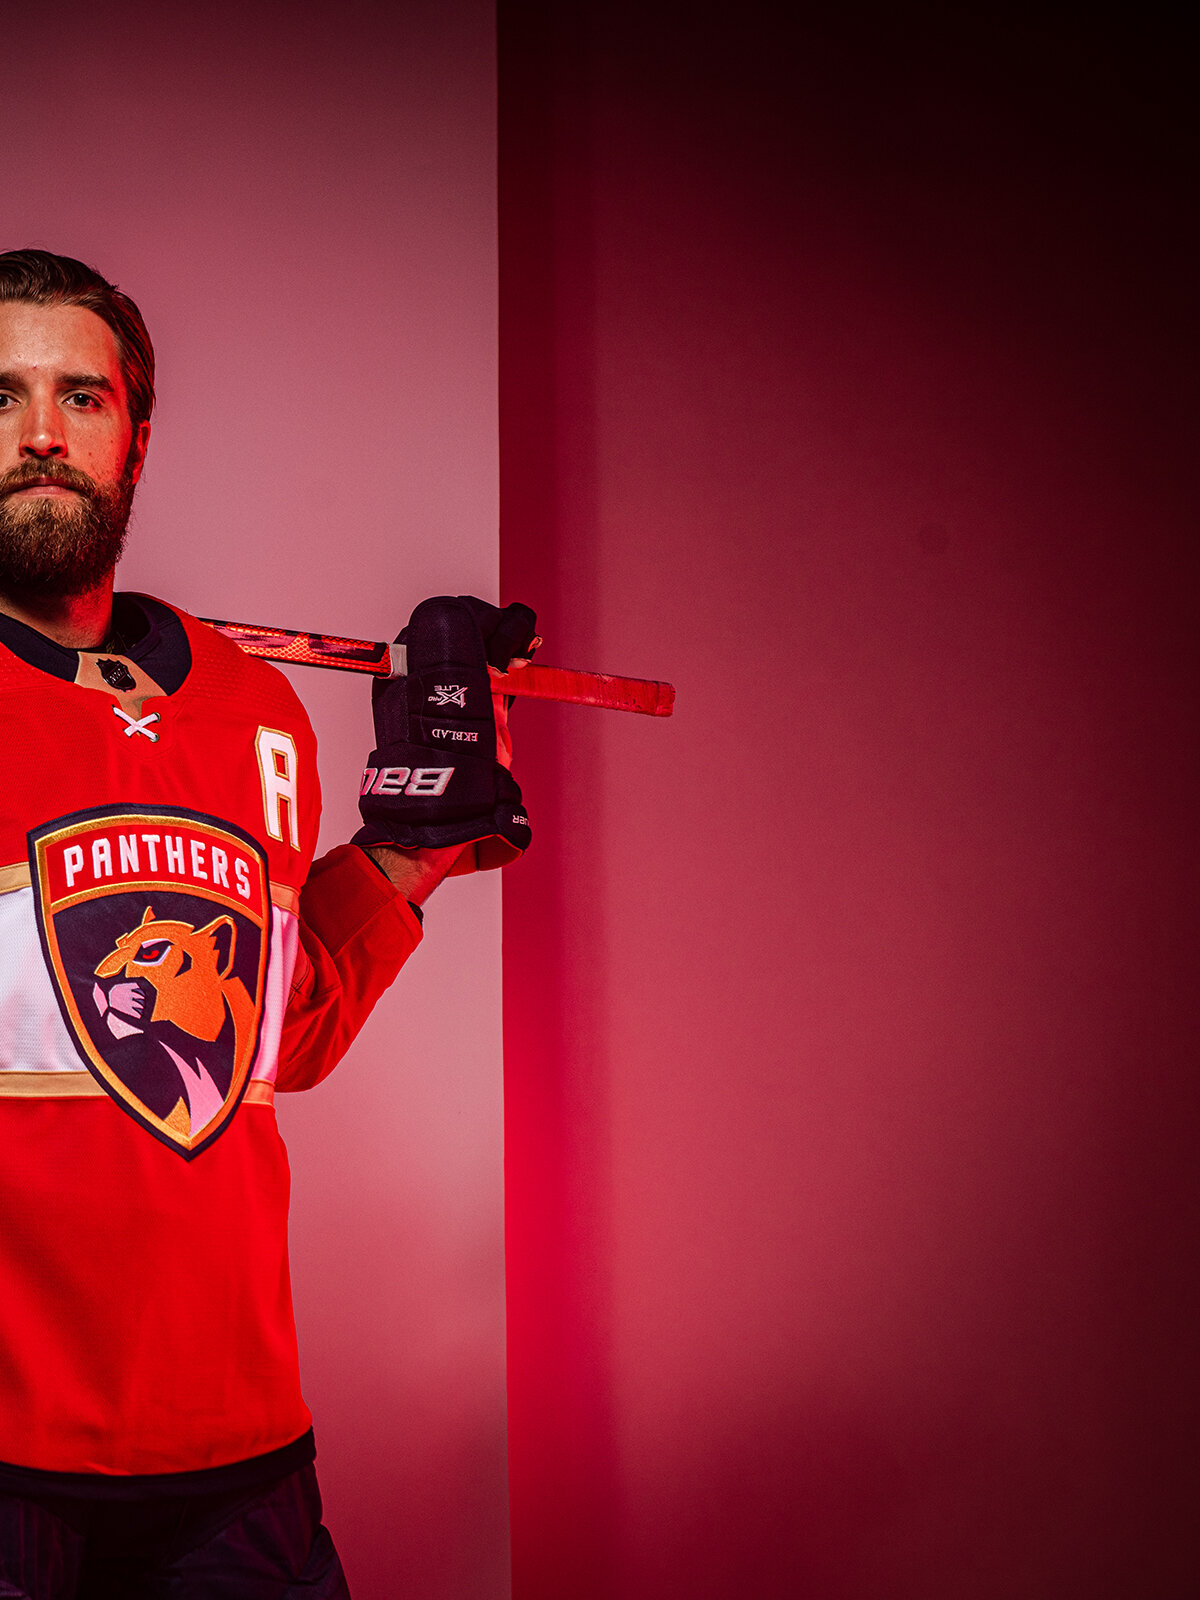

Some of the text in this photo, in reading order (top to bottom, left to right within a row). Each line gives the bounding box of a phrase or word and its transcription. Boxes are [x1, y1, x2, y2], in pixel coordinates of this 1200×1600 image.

[433, 684, 460, 692] LITE
[431, 728, 479, 742] EKBLAD
[254, 725, 302, 852] A
[63, 833, 251, 900] PANTHERS
